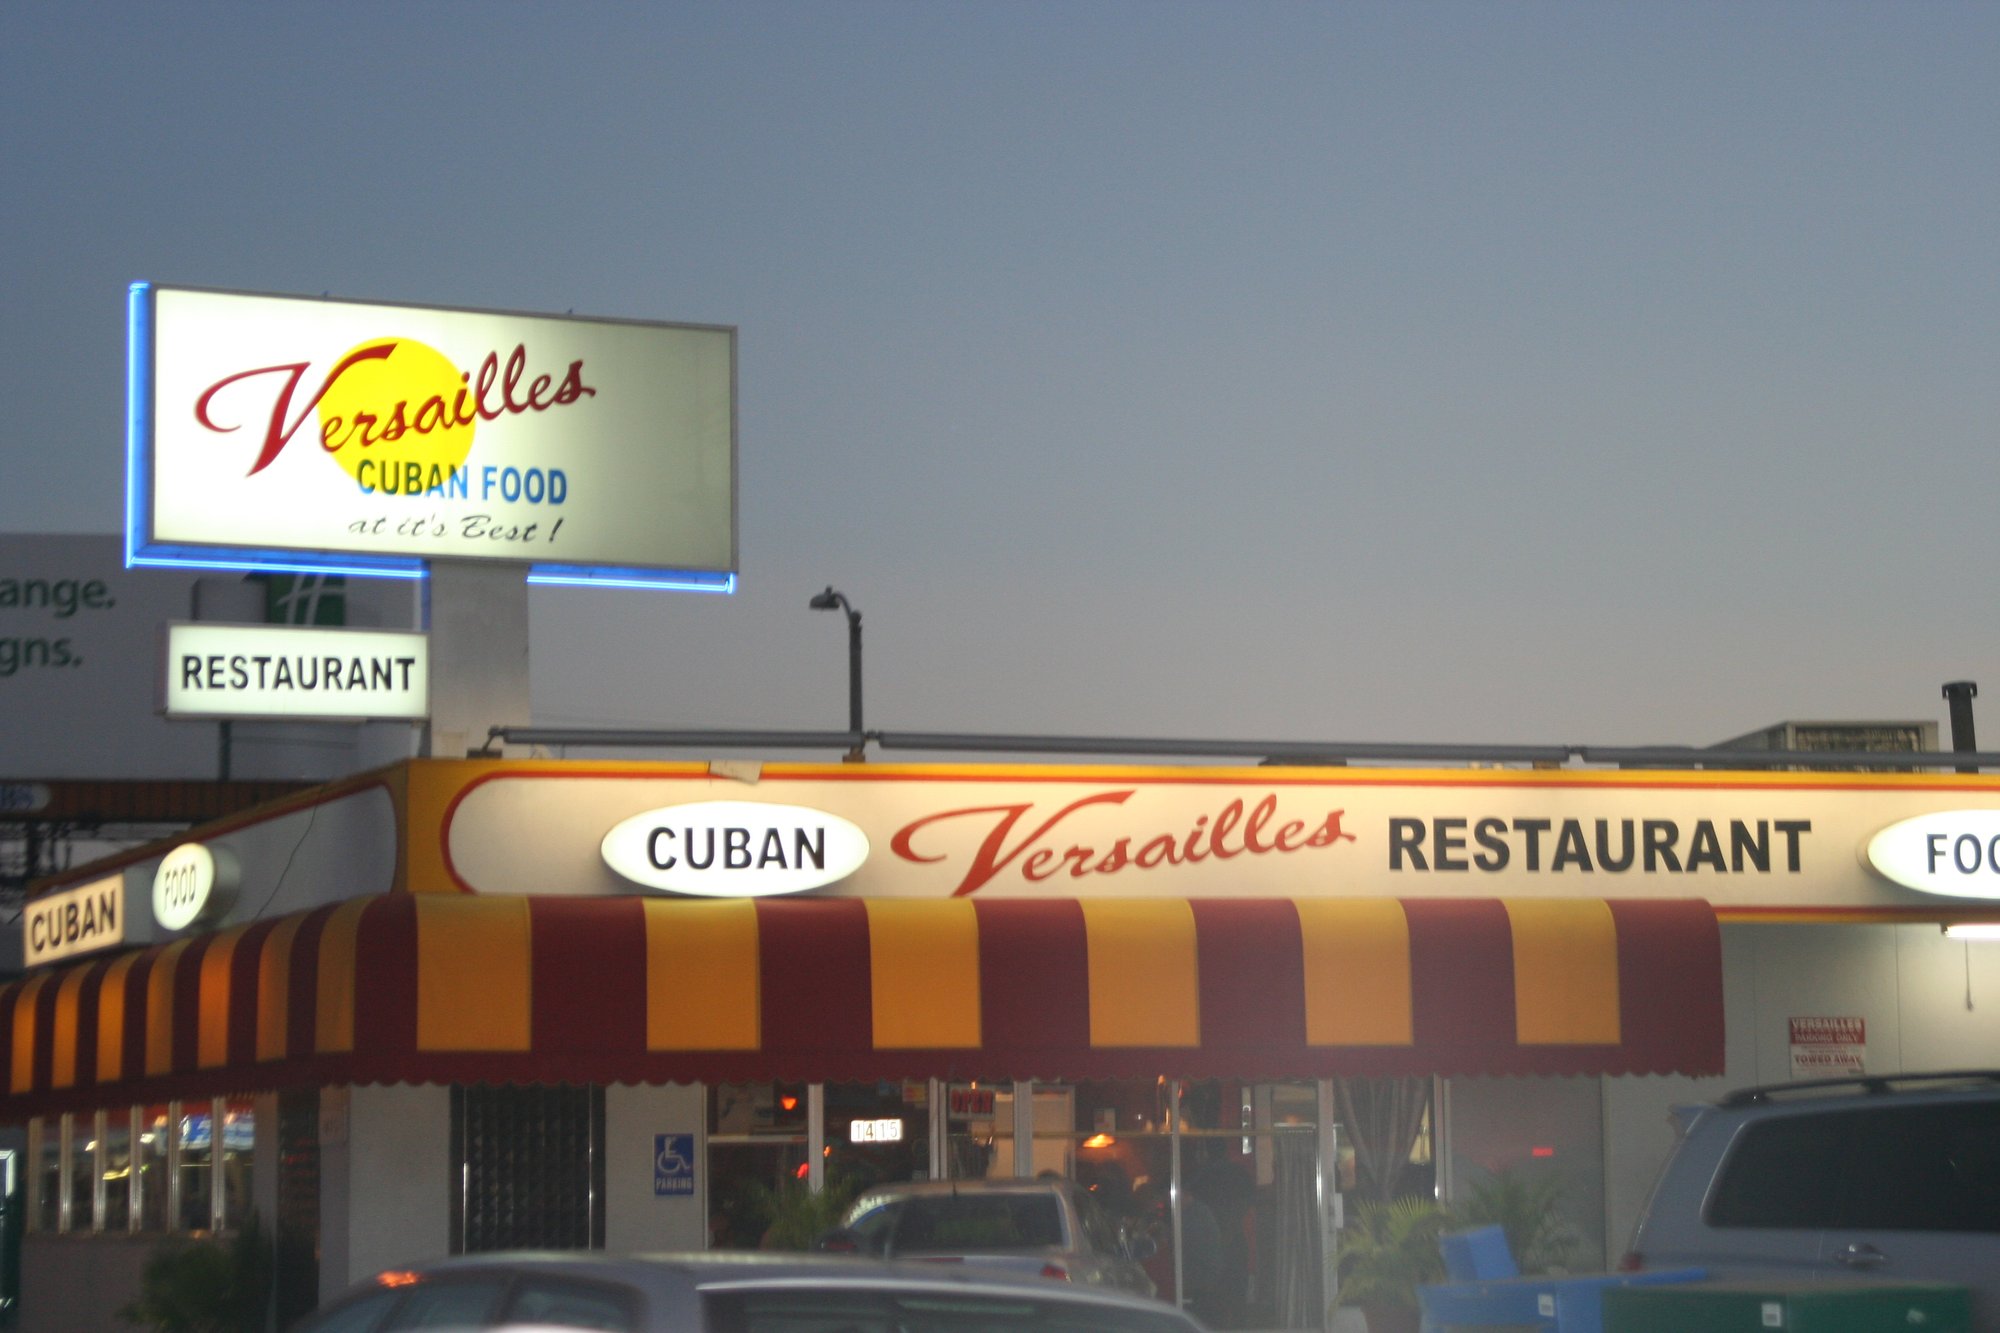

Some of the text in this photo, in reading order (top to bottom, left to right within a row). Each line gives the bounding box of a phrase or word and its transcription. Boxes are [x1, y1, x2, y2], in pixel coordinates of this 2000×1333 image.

[195, 343, 596, 478] Versailles
[357, 459, 567, 505] CUBAN FOOD
[349, 515, 386, 535] at
[397, 512, 446, 537] it's
[0, 579, 115, 618] ange.
[181, 654, 415, 691] RESTAURANT
[646, 826, 826, 871] CUBAN
[890, 790, 1812, 898] Versailles RESTAURANT
[164, 863, 196, 914] FOOD
[31, 887, 117, 954] CUBAN
[1791, 1018, 1862, 1030] VERSAILLES
[1794, 1054, 1862, 1065] TOWED AWAY
[951, 1089, 994, 1113] OPEN
[855, 1121, 898, 1139] 1415
[656, 1177, 692, 1190] PARKING
